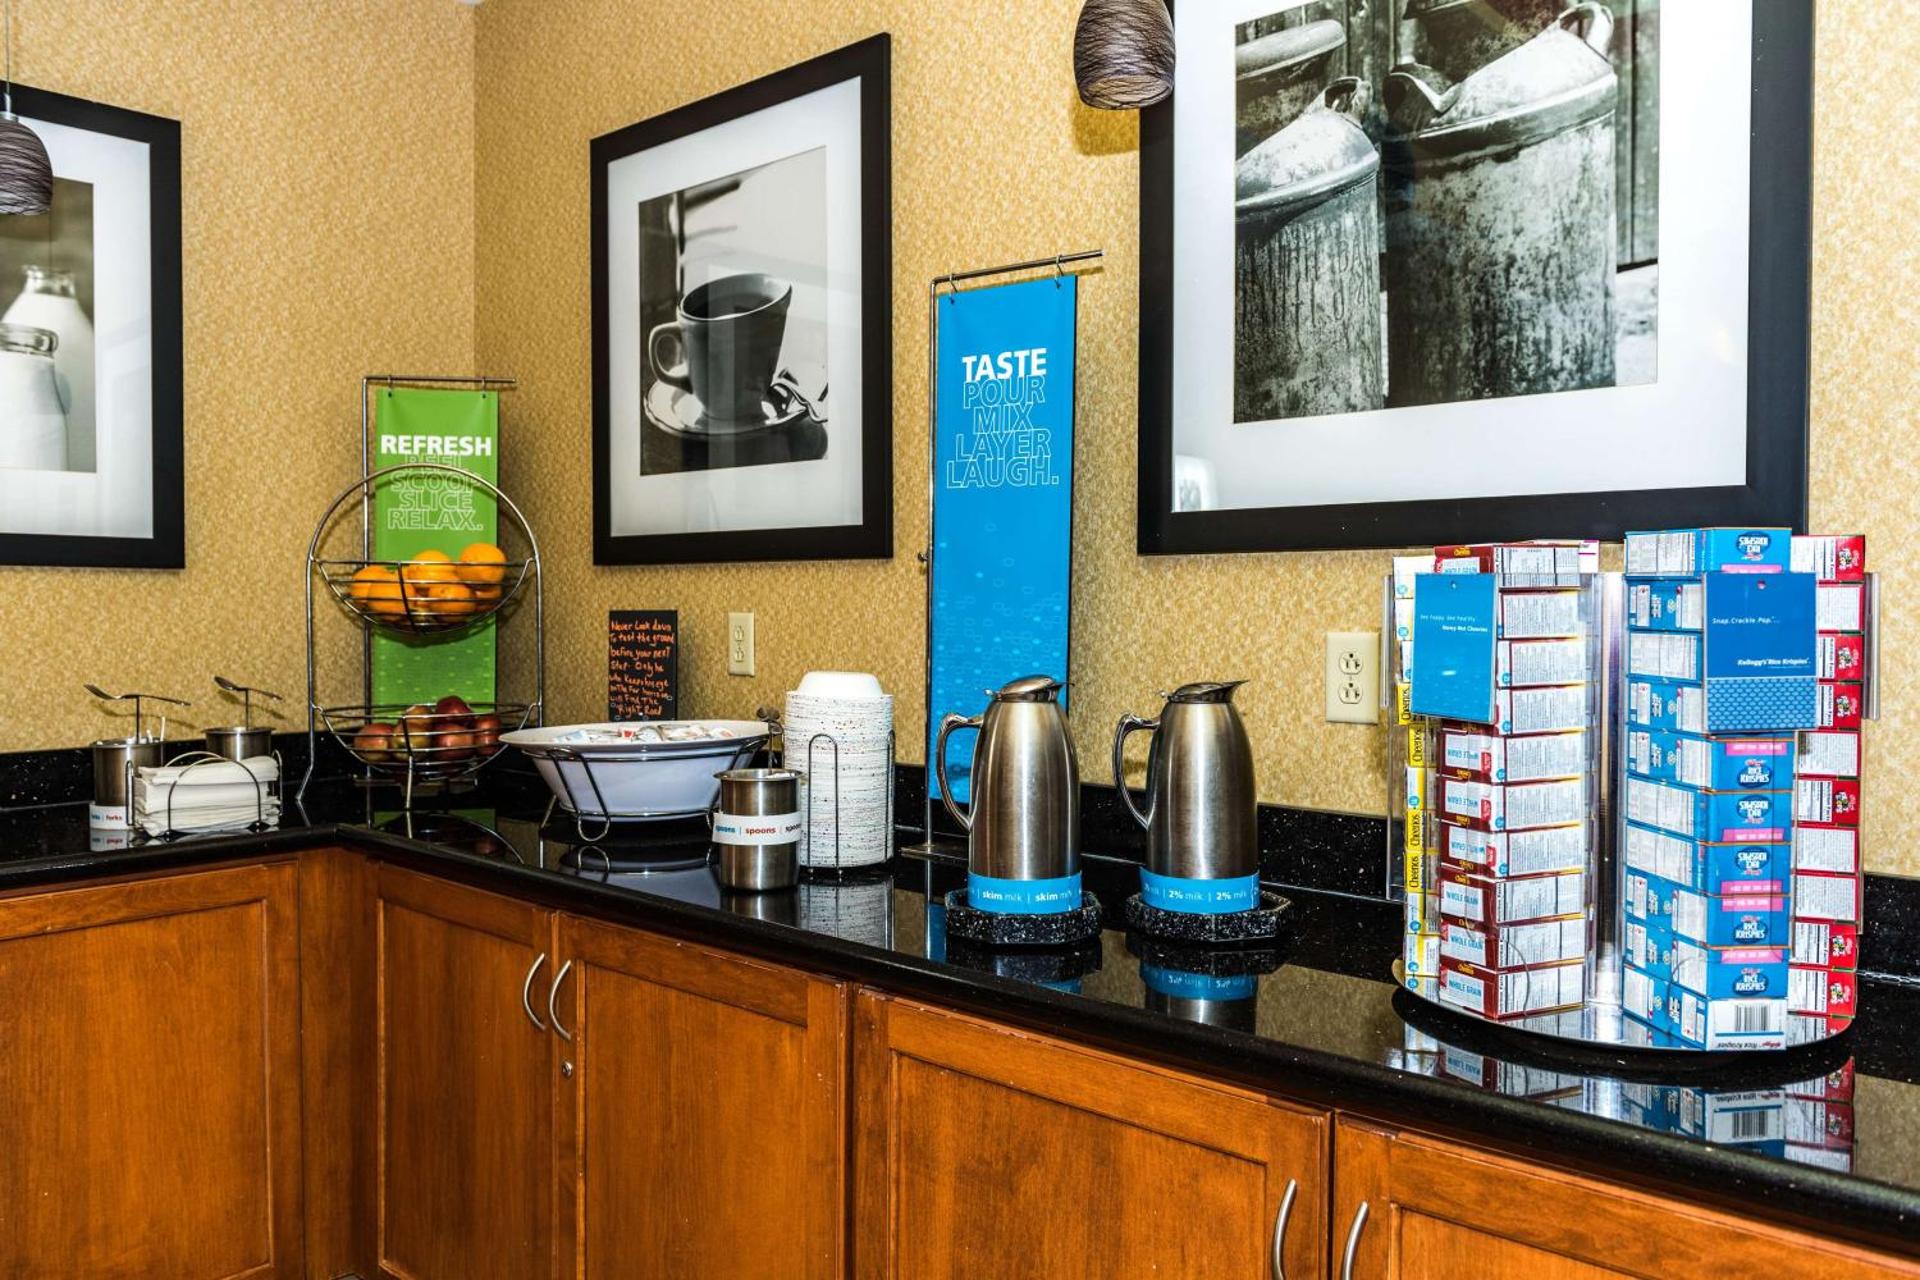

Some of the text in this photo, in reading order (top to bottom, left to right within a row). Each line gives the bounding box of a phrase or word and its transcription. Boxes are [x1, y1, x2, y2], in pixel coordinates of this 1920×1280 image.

[962, 348, 1047, 382] TASTE
[963, 375, 1046, 409] POUR
[973, 402, 1034, 434] MIX
[380, 434, 492, 456] REFRESH
[956, 428, 1052, 462] LAYER
[947, 455, 1060, 489] LAUGH.
[399, 490, 473, 511] SLICE
[387, 508, 485, 531] RELAX.
[745, 827, 776, 836] spoons
[1410, 814, 1420, 847] Cheerios
[1408, 856, 1418, 888] Cheerios
[982, 890, 1002, 900] skim
[1035, 893, 1058, 902] skim
[1168, 890, 1184, 900] 2%
[1216, 891, 1232, 900] 2%
